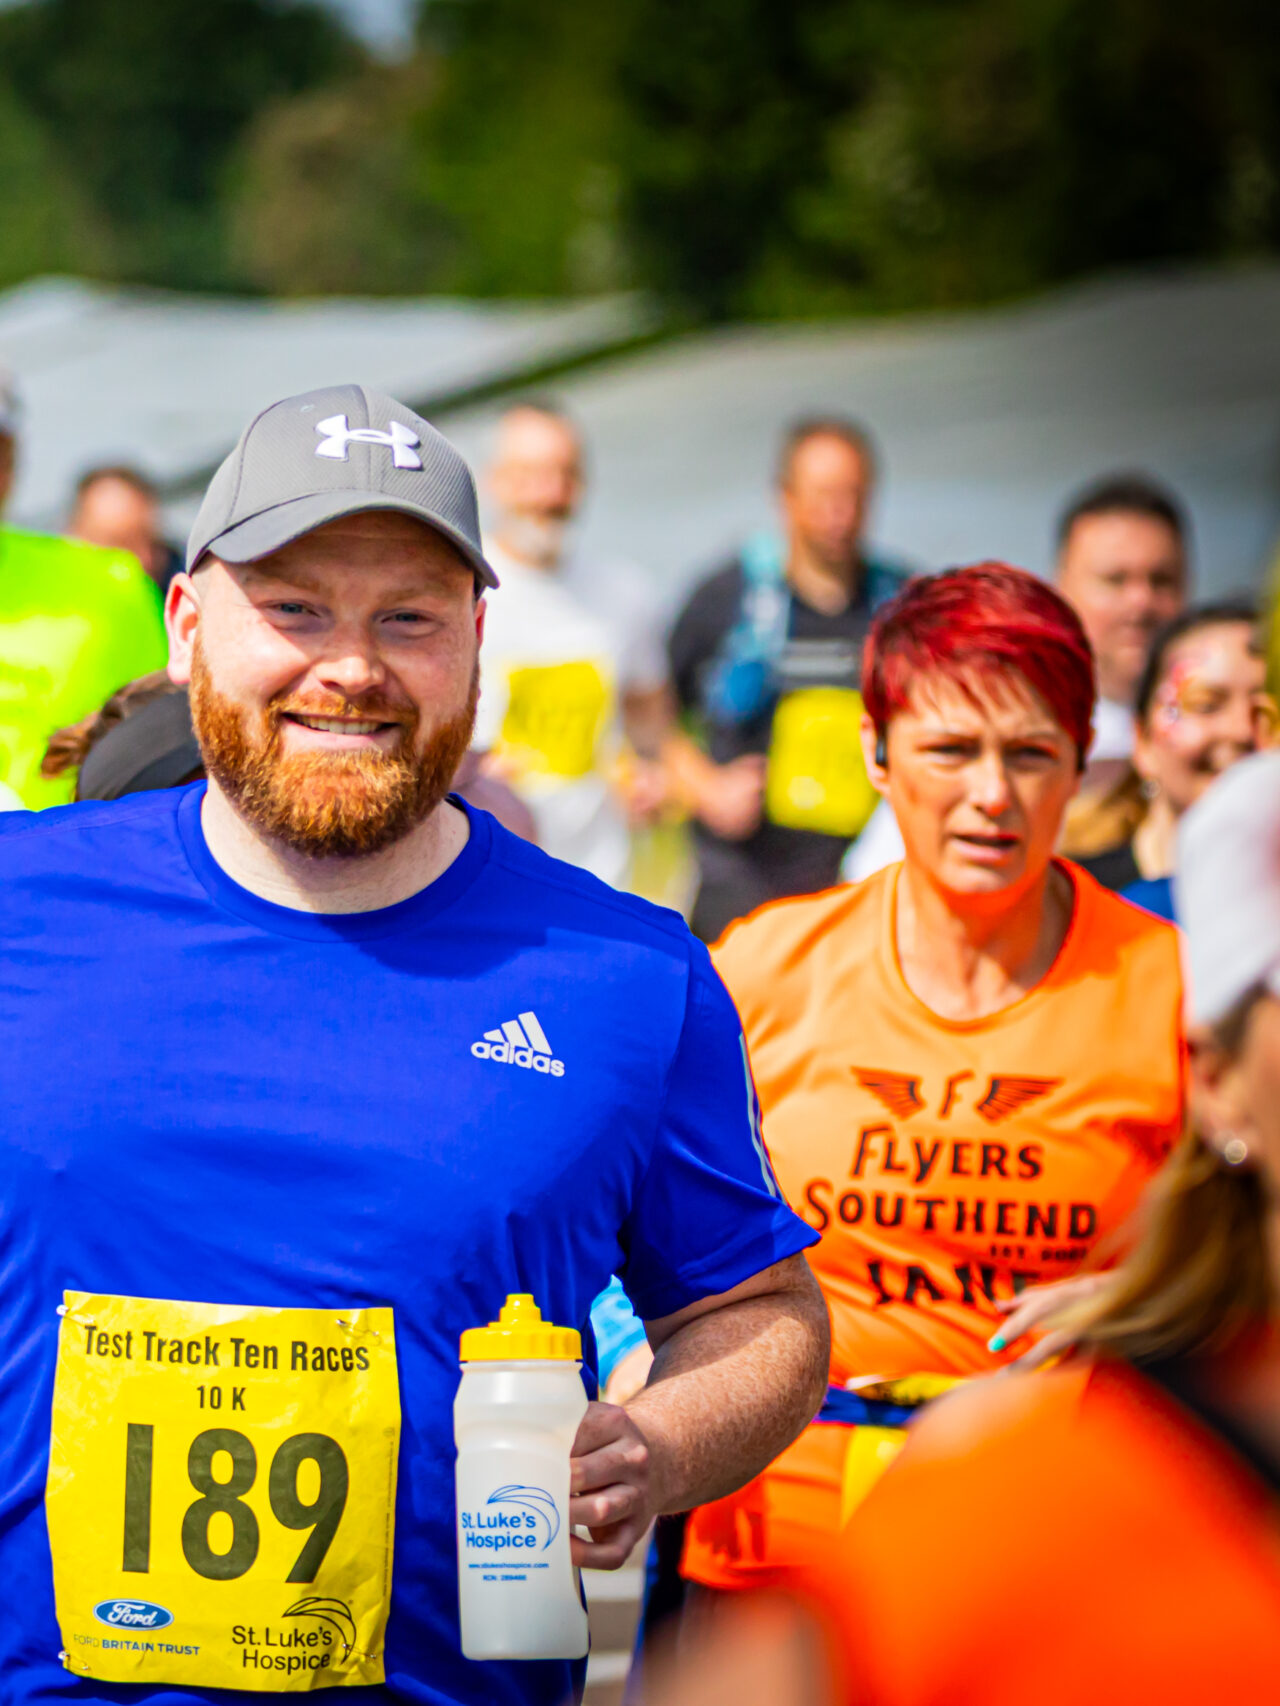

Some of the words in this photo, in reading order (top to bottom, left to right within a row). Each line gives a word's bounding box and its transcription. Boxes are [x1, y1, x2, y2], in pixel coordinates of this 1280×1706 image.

[471, 1041, 565, 1077] adidas
[804, 1179, 1098, 1240] SOUTHEND
[84, 1324, 132, 1360] Test
[143, 1331, 220, 1366] Track
[230, 1337, 278, 1370] Ten
[291, 1340, 370, 1372] Races
[197, 1385, 221, 1410] 10
[232, 1386, 246, 1411] K
[122, 1422, 349, 1583] 189
[465, 1531, 537, 1552] Hospice
[107, 1602, 158, 1626] Ford
[73, 1634, 100, 1648] FORD
[102, 1639, 154, 1652] BRITAIN
[157, 1643, 200, 1656] TRUST
[242, 1648, 331, 1675] Hospice
